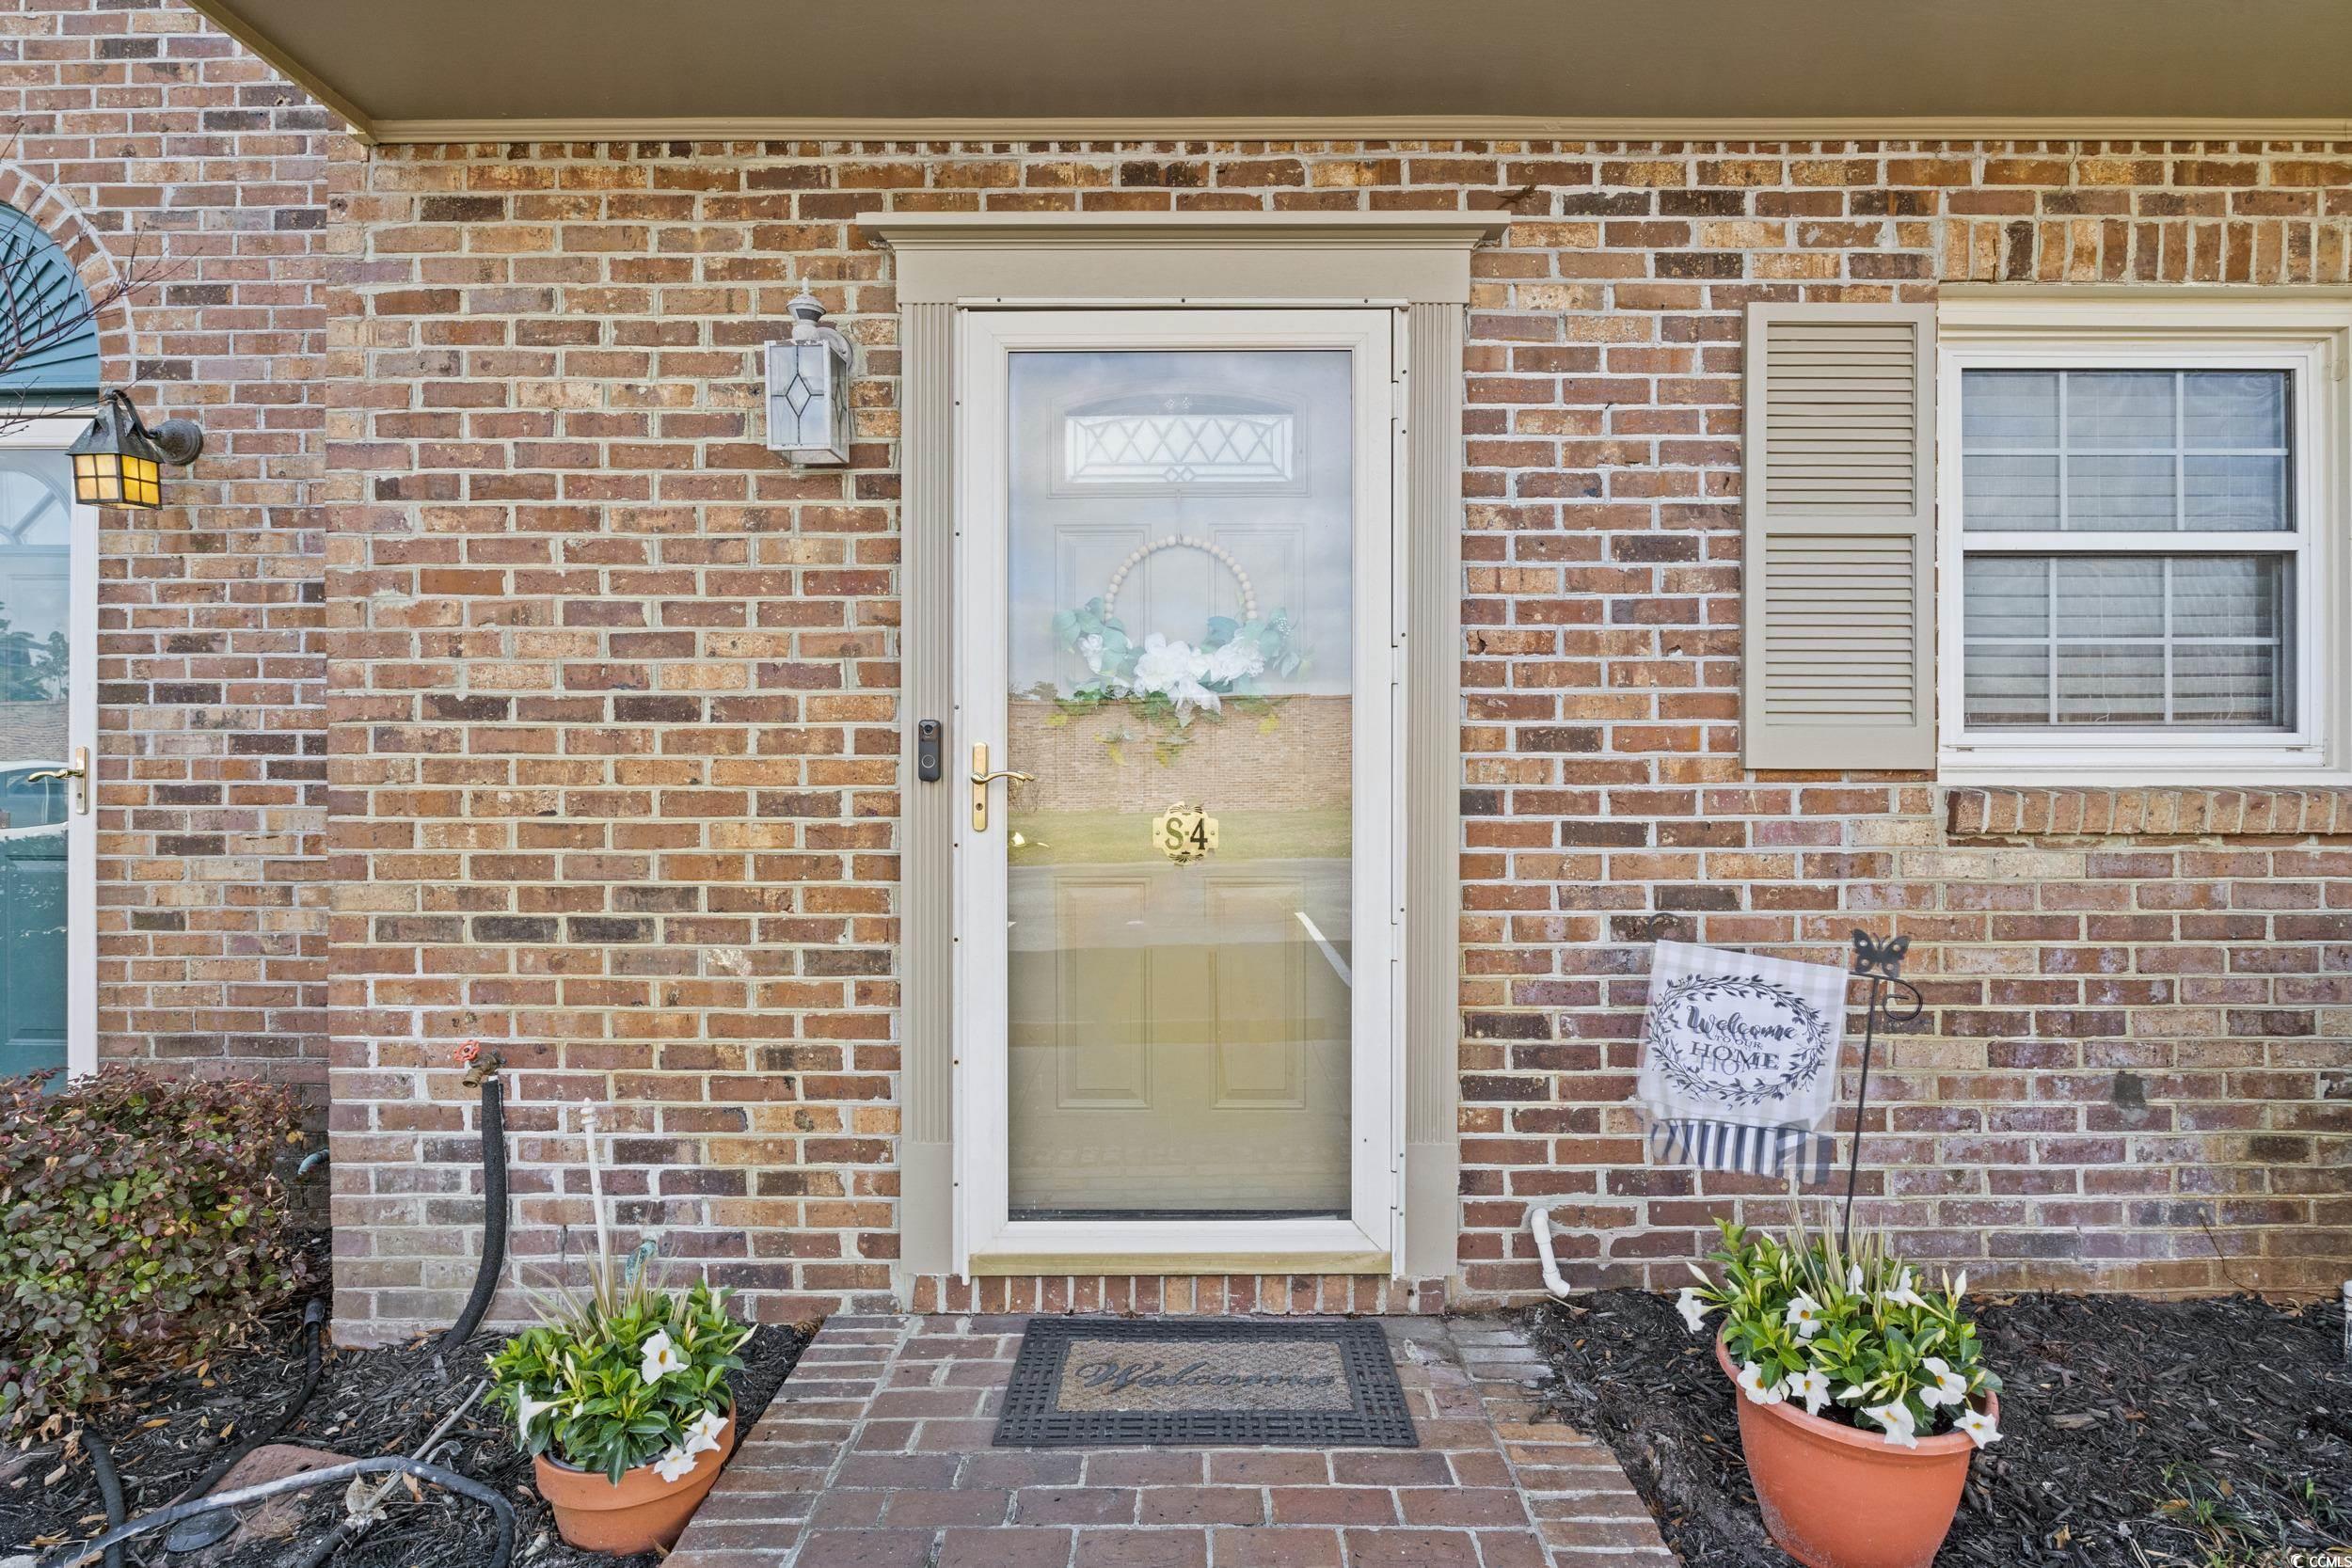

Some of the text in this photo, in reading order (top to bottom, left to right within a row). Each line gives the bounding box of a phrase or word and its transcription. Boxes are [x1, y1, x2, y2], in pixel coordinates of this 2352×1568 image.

[1687, 1005, 1796, 1041] Welcome
[1690, 1041, 1780, 1072] HOME
[1715, 1035, 1763, 1050] TO OUR
[1075, 1361, 1335, 1393] Welcome
